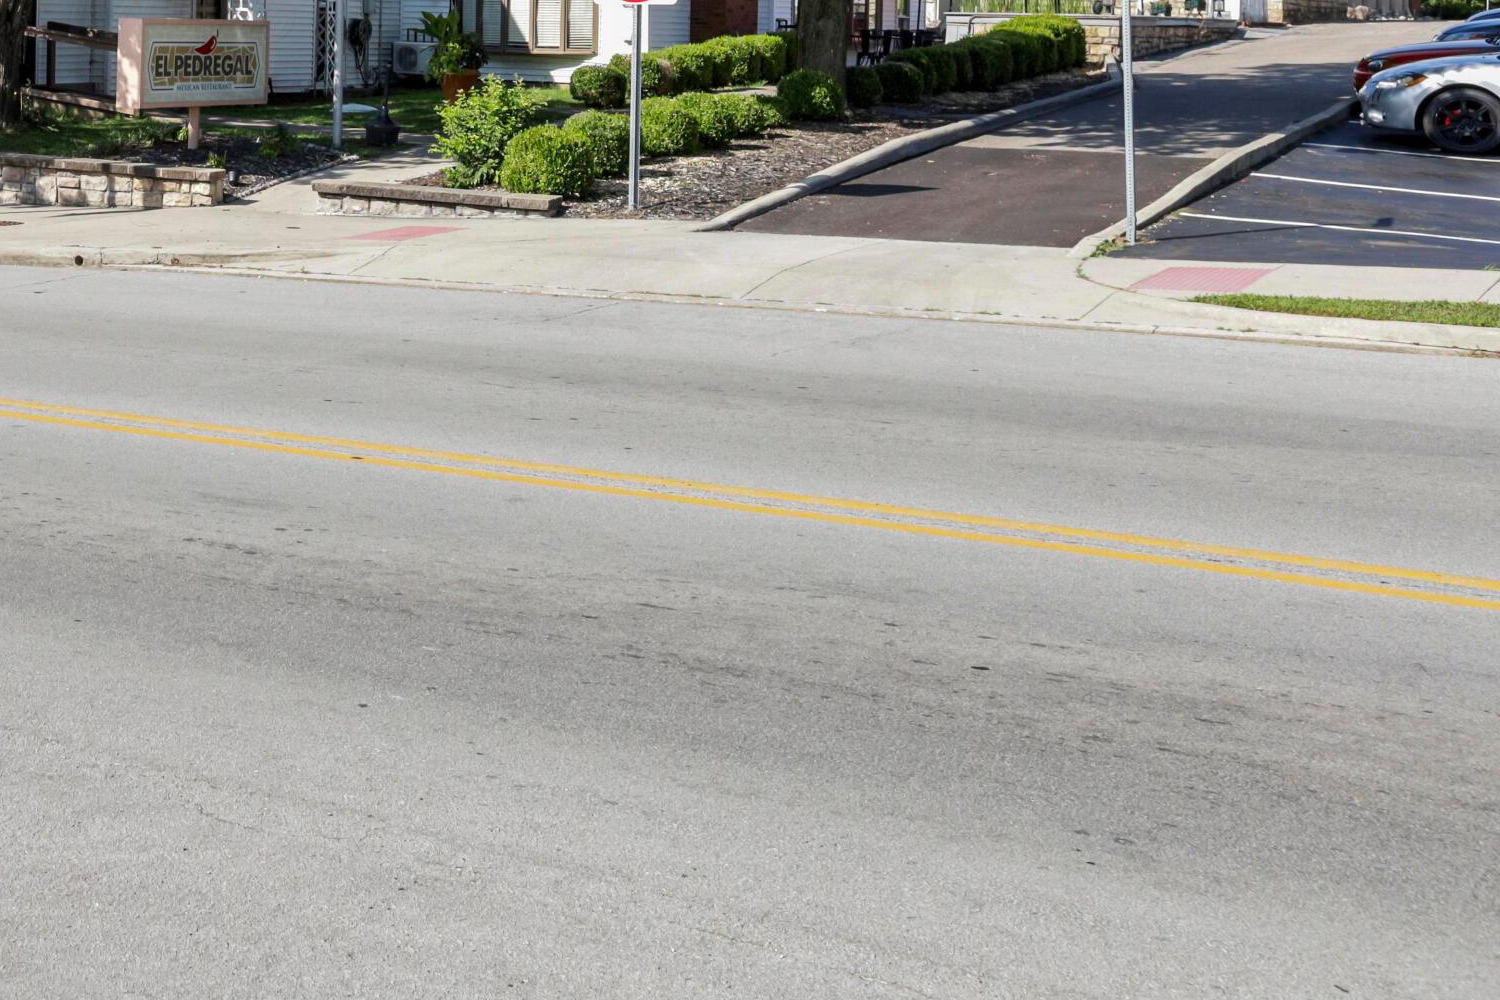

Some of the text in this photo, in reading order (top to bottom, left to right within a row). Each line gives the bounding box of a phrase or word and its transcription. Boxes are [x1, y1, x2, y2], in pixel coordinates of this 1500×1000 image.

[154, 55, 253, 77] EL PEDREGAL
[176, 83, 200, 91] MEXICAN
